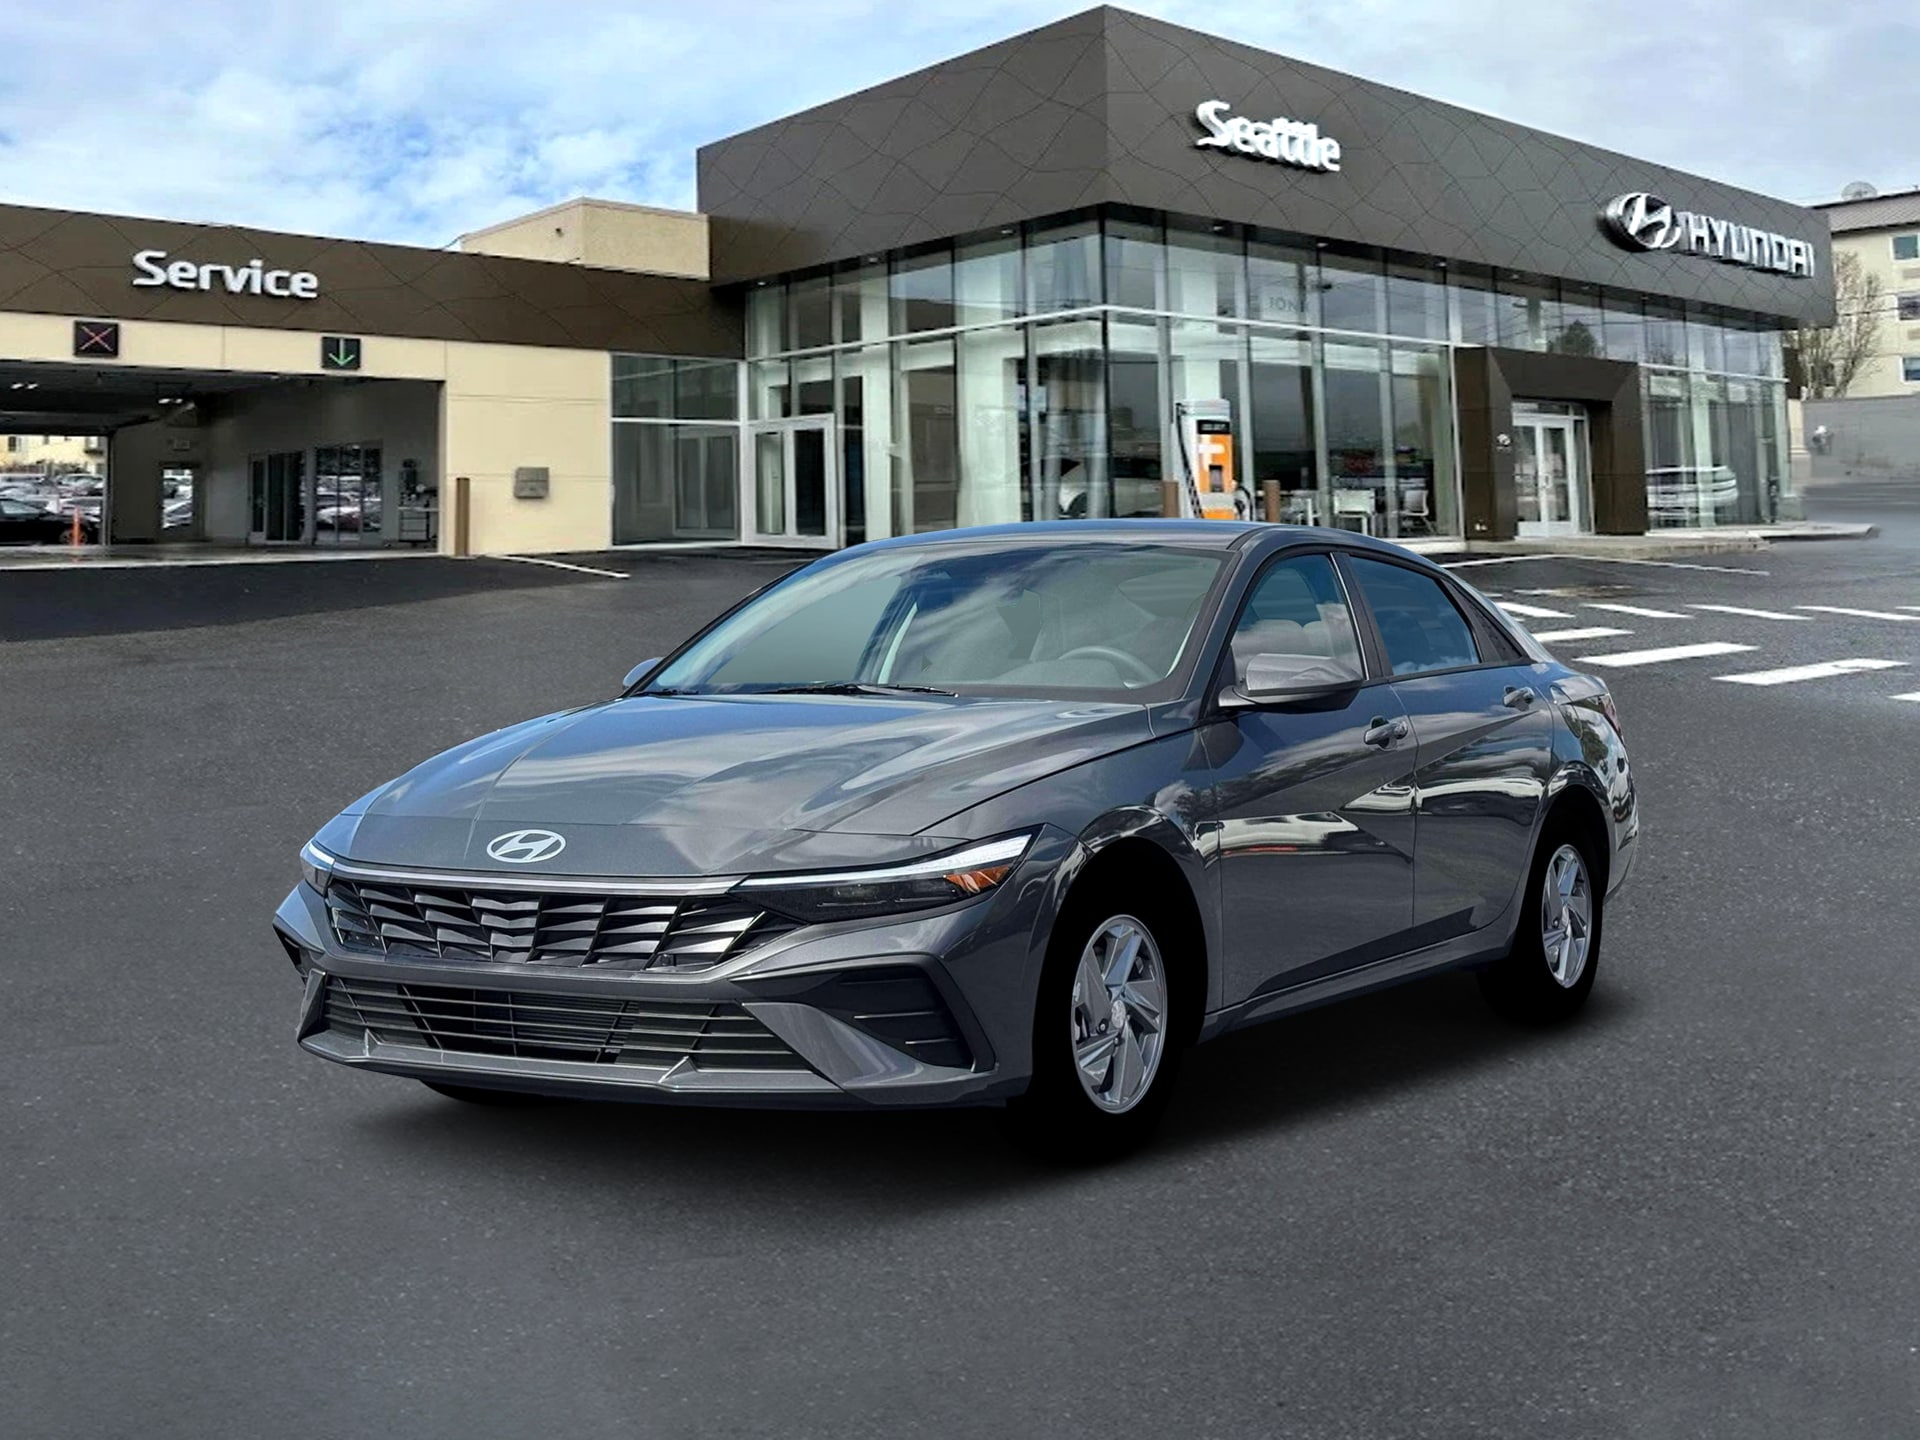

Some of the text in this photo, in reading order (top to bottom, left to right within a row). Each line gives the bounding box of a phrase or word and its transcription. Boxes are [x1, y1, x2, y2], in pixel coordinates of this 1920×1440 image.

[1196, 100, 1341, 171] Seattle
[132, 249, 319, 299] Service
[1682, 212, 1815, 277] HYUNDAI
